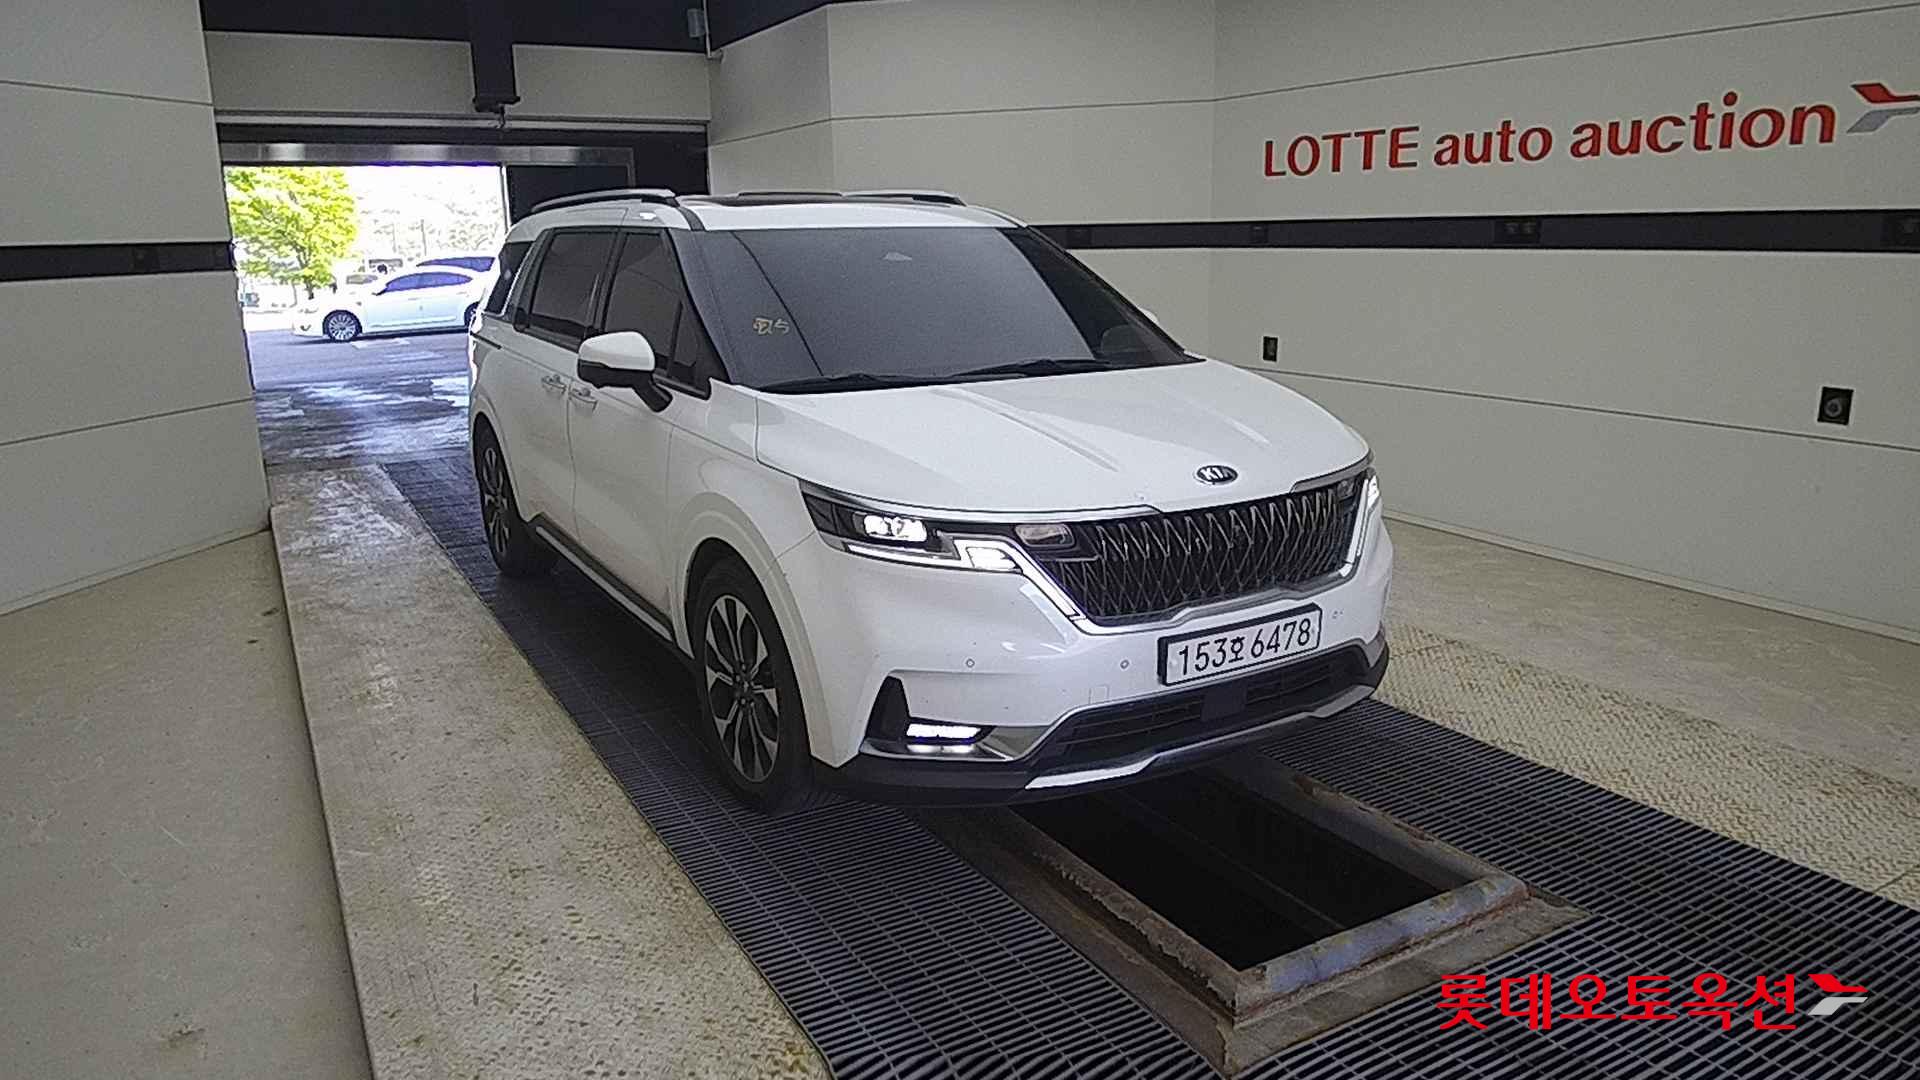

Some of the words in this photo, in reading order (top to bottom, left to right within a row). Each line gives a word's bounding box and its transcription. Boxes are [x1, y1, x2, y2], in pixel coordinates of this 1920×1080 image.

[1264, 125, 1420, 177] LOTTE
[1433, 119, 1554, 165] auto
[1571, 91, 1837, 158] auction
[1199, 466, 1237, 481] KIA
